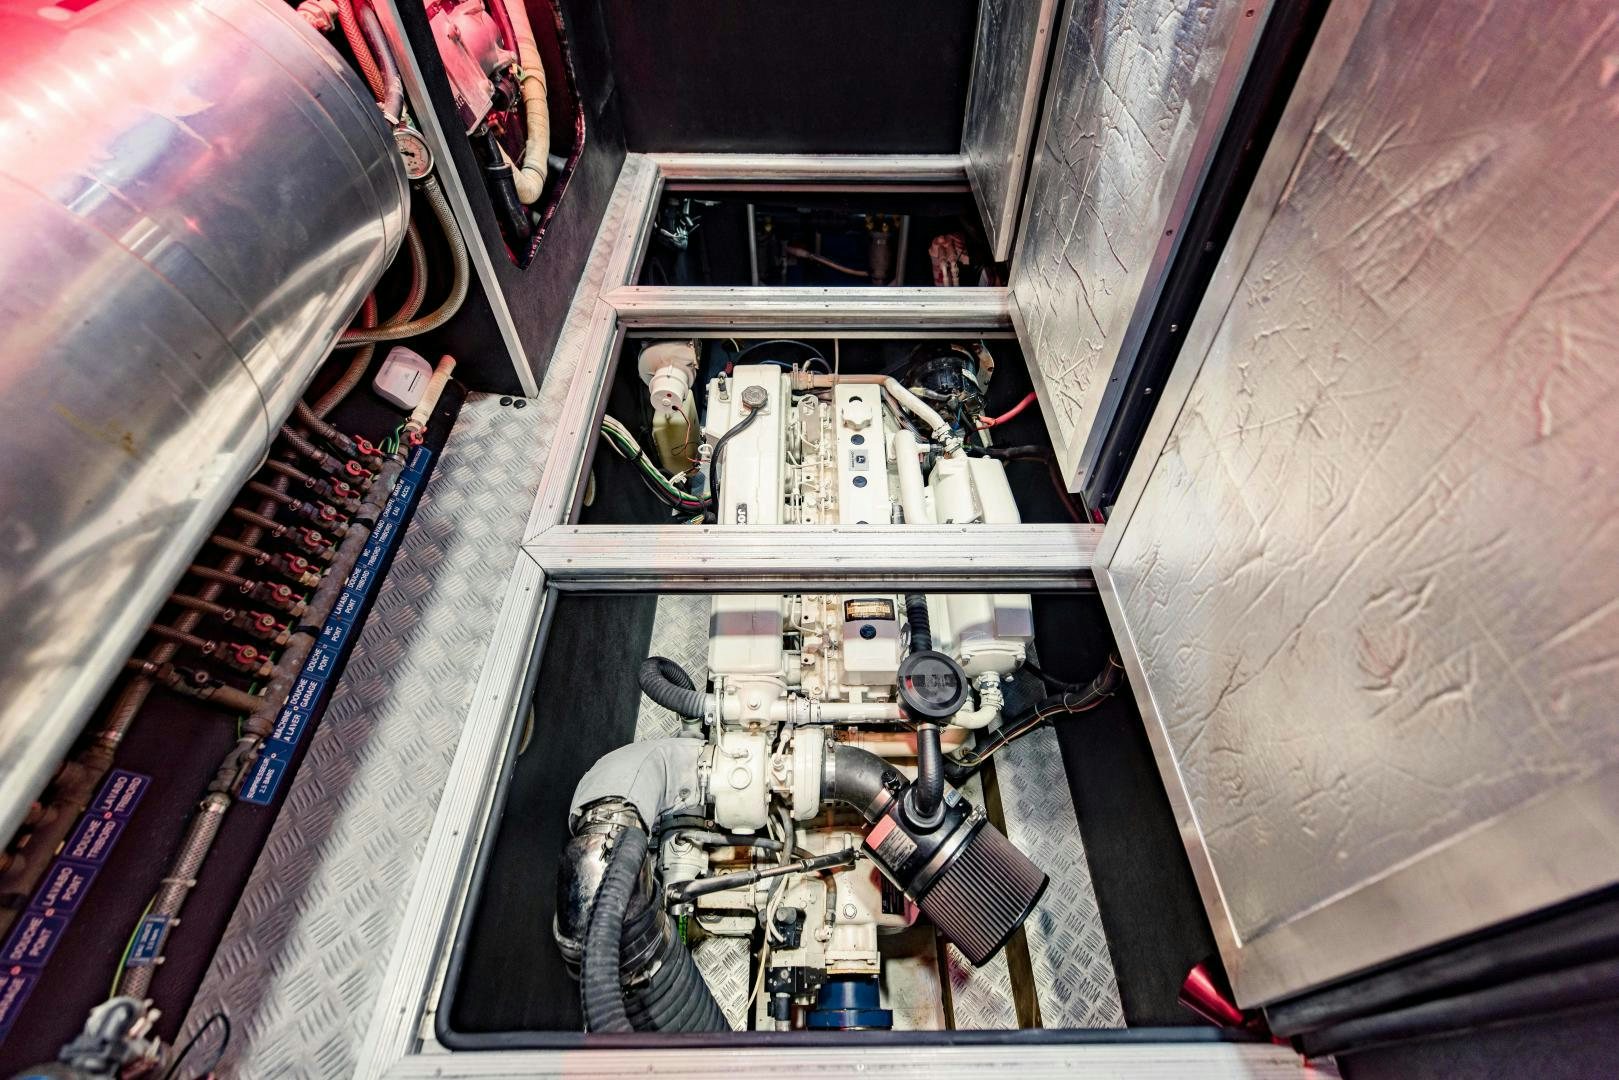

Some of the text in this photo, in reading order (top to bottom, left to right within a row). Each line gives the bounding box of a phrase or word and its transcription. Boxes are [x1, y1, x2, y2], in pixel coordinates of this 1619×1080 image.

[372, 520, 384, 538] LAVABO
[379, 523, 392, 542] TRIBORD
[368, 546, 380, 566] TRIBORD
[348, 568, 361, 588] DOUCHE
[356, 570, 369, 591] TRIBORD
[334, 592, 350, 614] LAVABO
[345, 599, 356, 614] PONT
[324, 626, 333, 636] WC
[332, 626, 342, 642] PONT
[307, 648, 322, 672] DOUCHE
[318, 654, 330, 671] PONT
[290, 678, 308, 705] DOUCHE
[300, 681, 318, 708] GARAGE
[273, 710, 292, 739] MACHINE
[288, 714, 301, 736] LAVER
[246, 757, 270, 800] SURPRESSEUR
[263, 768, 275, 787] BARS
[101, 776, 128, 810] LAVABO
[114, 776, 142, 812] TRIBORD
[72, 820, 102, 856] DOUCHE
[86, 821, 116, 858] TRIBORD
[42, 867, 72, 906] LAVABO
[62, 874, 84, 900] PONT
[10, 917, 44, 959] DOUCHE
[28, 928, 52, 956] PONT
